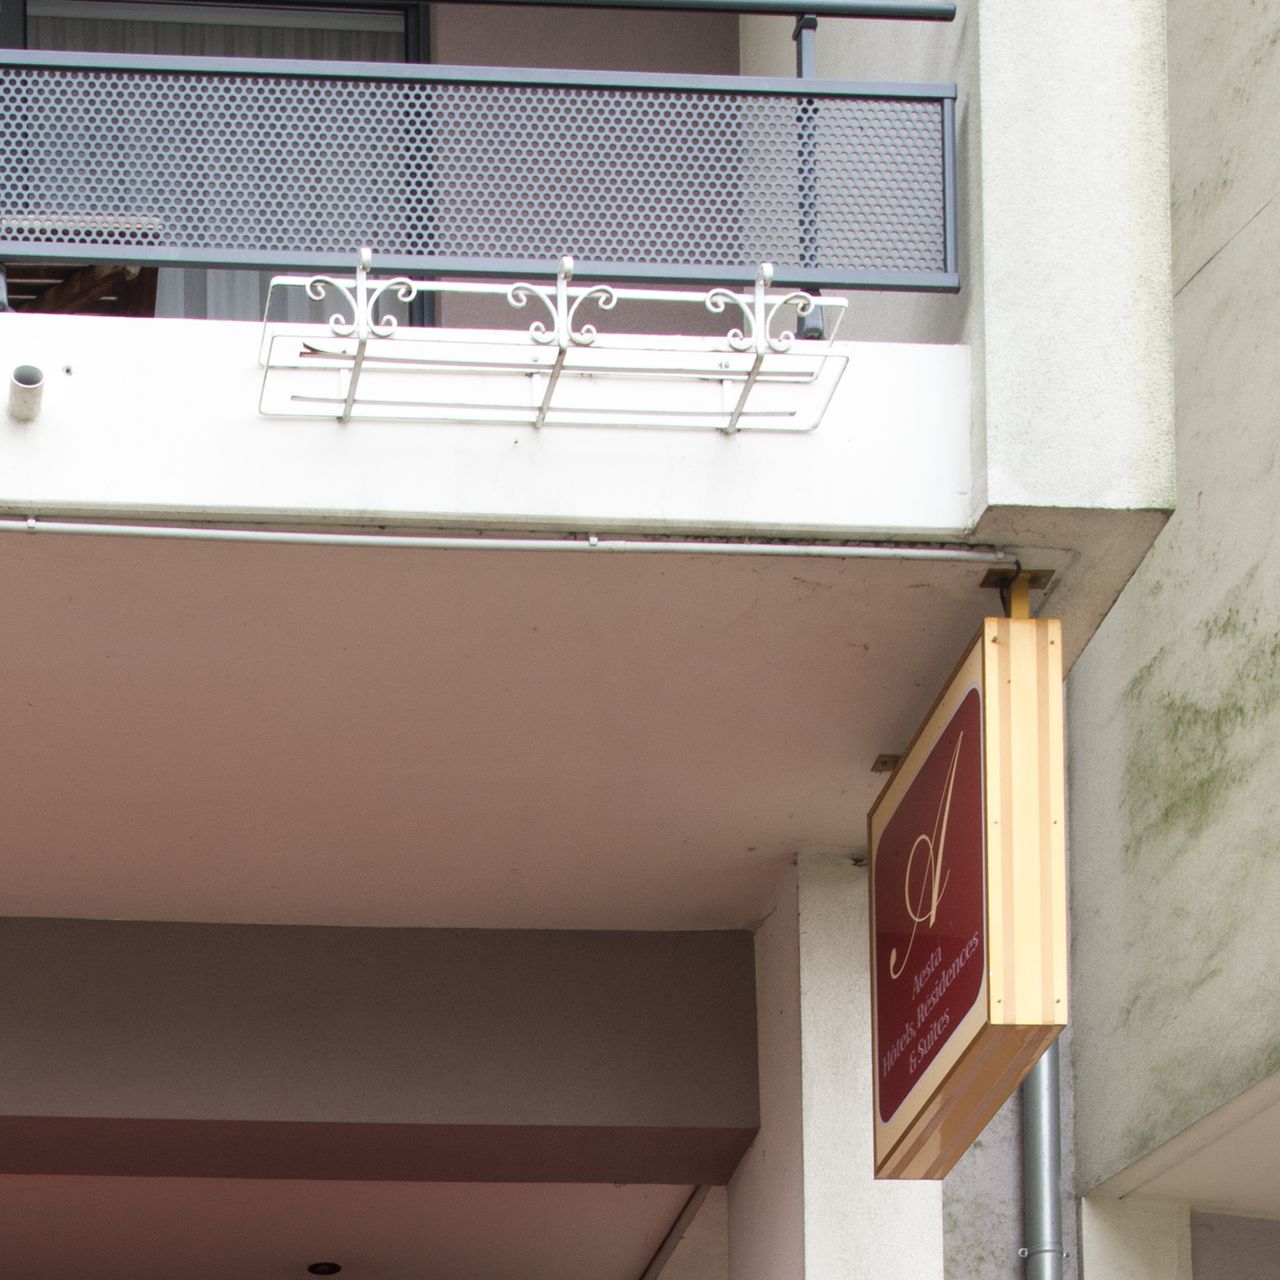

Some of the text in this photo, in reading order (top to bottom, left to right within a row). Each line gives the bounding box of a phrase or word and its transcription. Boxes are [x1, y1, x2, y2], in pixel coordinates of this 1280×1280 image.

[912, 946, 942, 1000] Aesta
[916, 931, 979, 1028] Résidences
[919, 1007, 950, 1063] Suites
